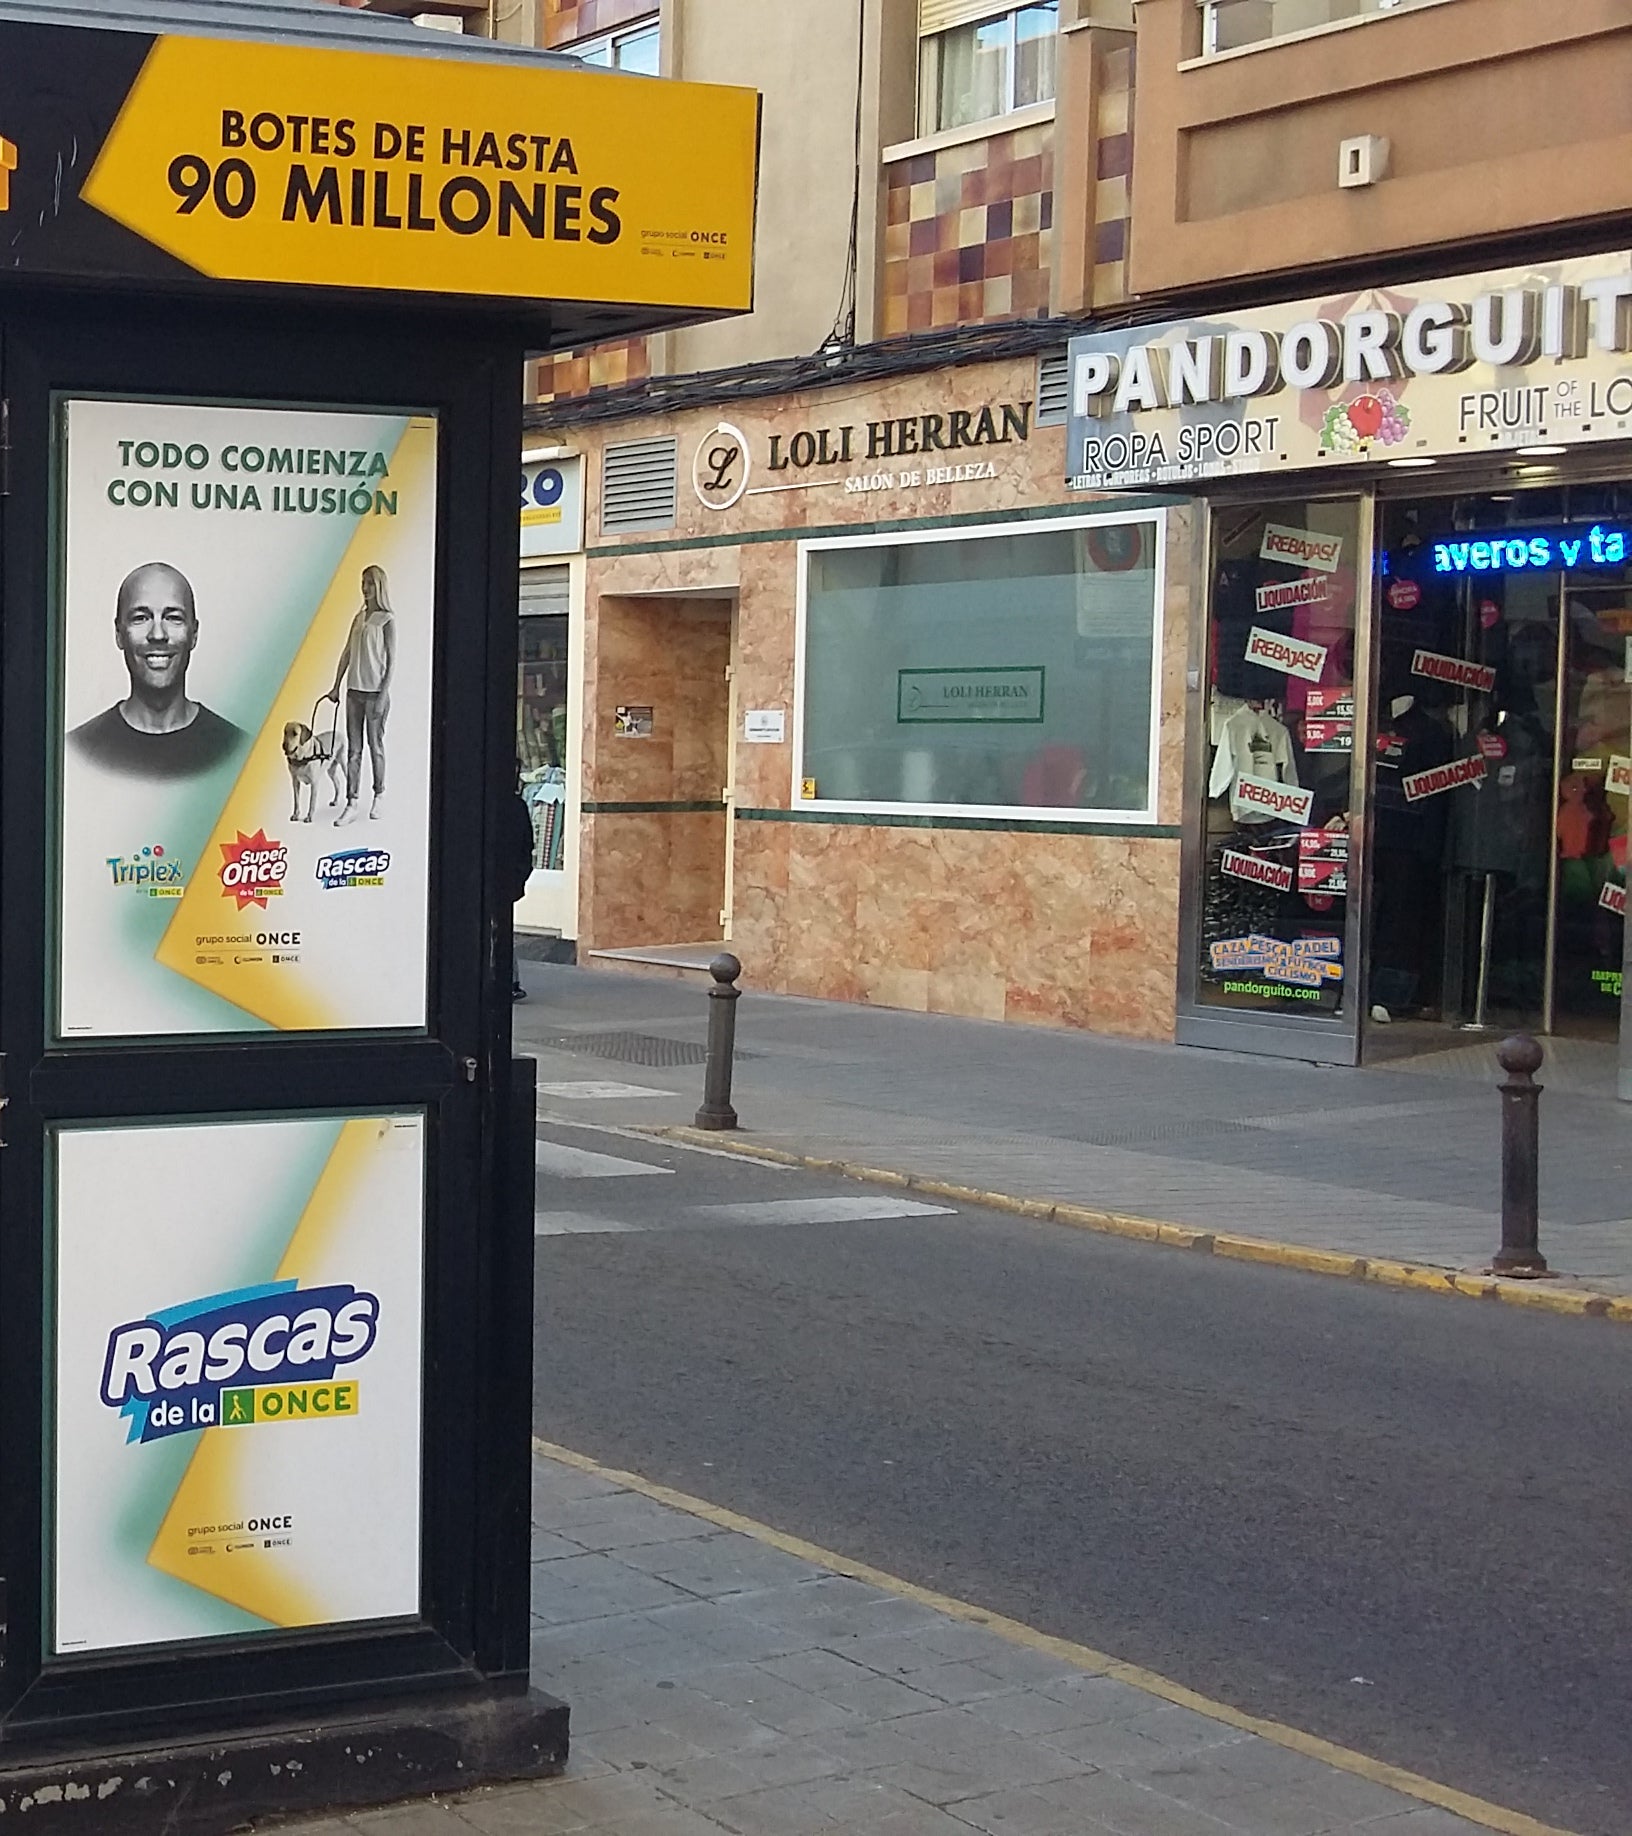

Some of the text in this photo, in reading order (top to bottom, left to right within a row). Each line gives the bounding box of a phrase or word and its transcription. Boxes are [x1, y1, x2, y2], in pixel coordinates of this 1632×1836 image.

[221, 109, 579, 176] BOTES DE HASTA
[167, 154, 623, 247] 90 MILLONES
[690, 231, 727, 245] ONCE
[1556, 380, 1578, 397] OF
[1460, 386, 1550, 431] FRUIT
[1554, 400, 1581, 418] THE
[767, 401, 1034, 471] LOLI HERRAN
[1084, 417, 1279, 473] ROPA SPORT
[118, 440, 390, 478] TODO COMIENZA
[844, 461, 998, 494] SALÓN DE BELLEZA
[107, 479, 398, 516] CON UNA ILUSIÓN
[1266, 530, 1339, 562] ¡REBAJAS!
[1257, 577, 1328, 610] LIQUIDACIÓN
[1251, 633, 1323, 672] ¡REBAJAS!
[1415, 654, 1495, 691] LIQUIDACIÓN
[943, 684, 1029, 699] LOLI HERRAN
[1238, 778, 1310, 815] ¡REBAJAS!
[106, 856, 182, 885] Triplex
[222, 861, 287, 886] Once
[239, 848, 287, 866] Super
[317, 854, 389, 878] Rascas
[1223, 853, 1291, 889] LIQUIDACIÓN
[159, 888, 182, 896] ONCE
[357, 877, 384, 886] ONCE
[195, 932, 301, 946] grupo social ONCE
[1223, 981, 1321, 1000] pandorguito.com
[106, 1298, 374, 1400] Rascas
[150, 1385, 352, 1428] de la ONCE
[187, 1515, 292, 1537] grupo social ONCE
